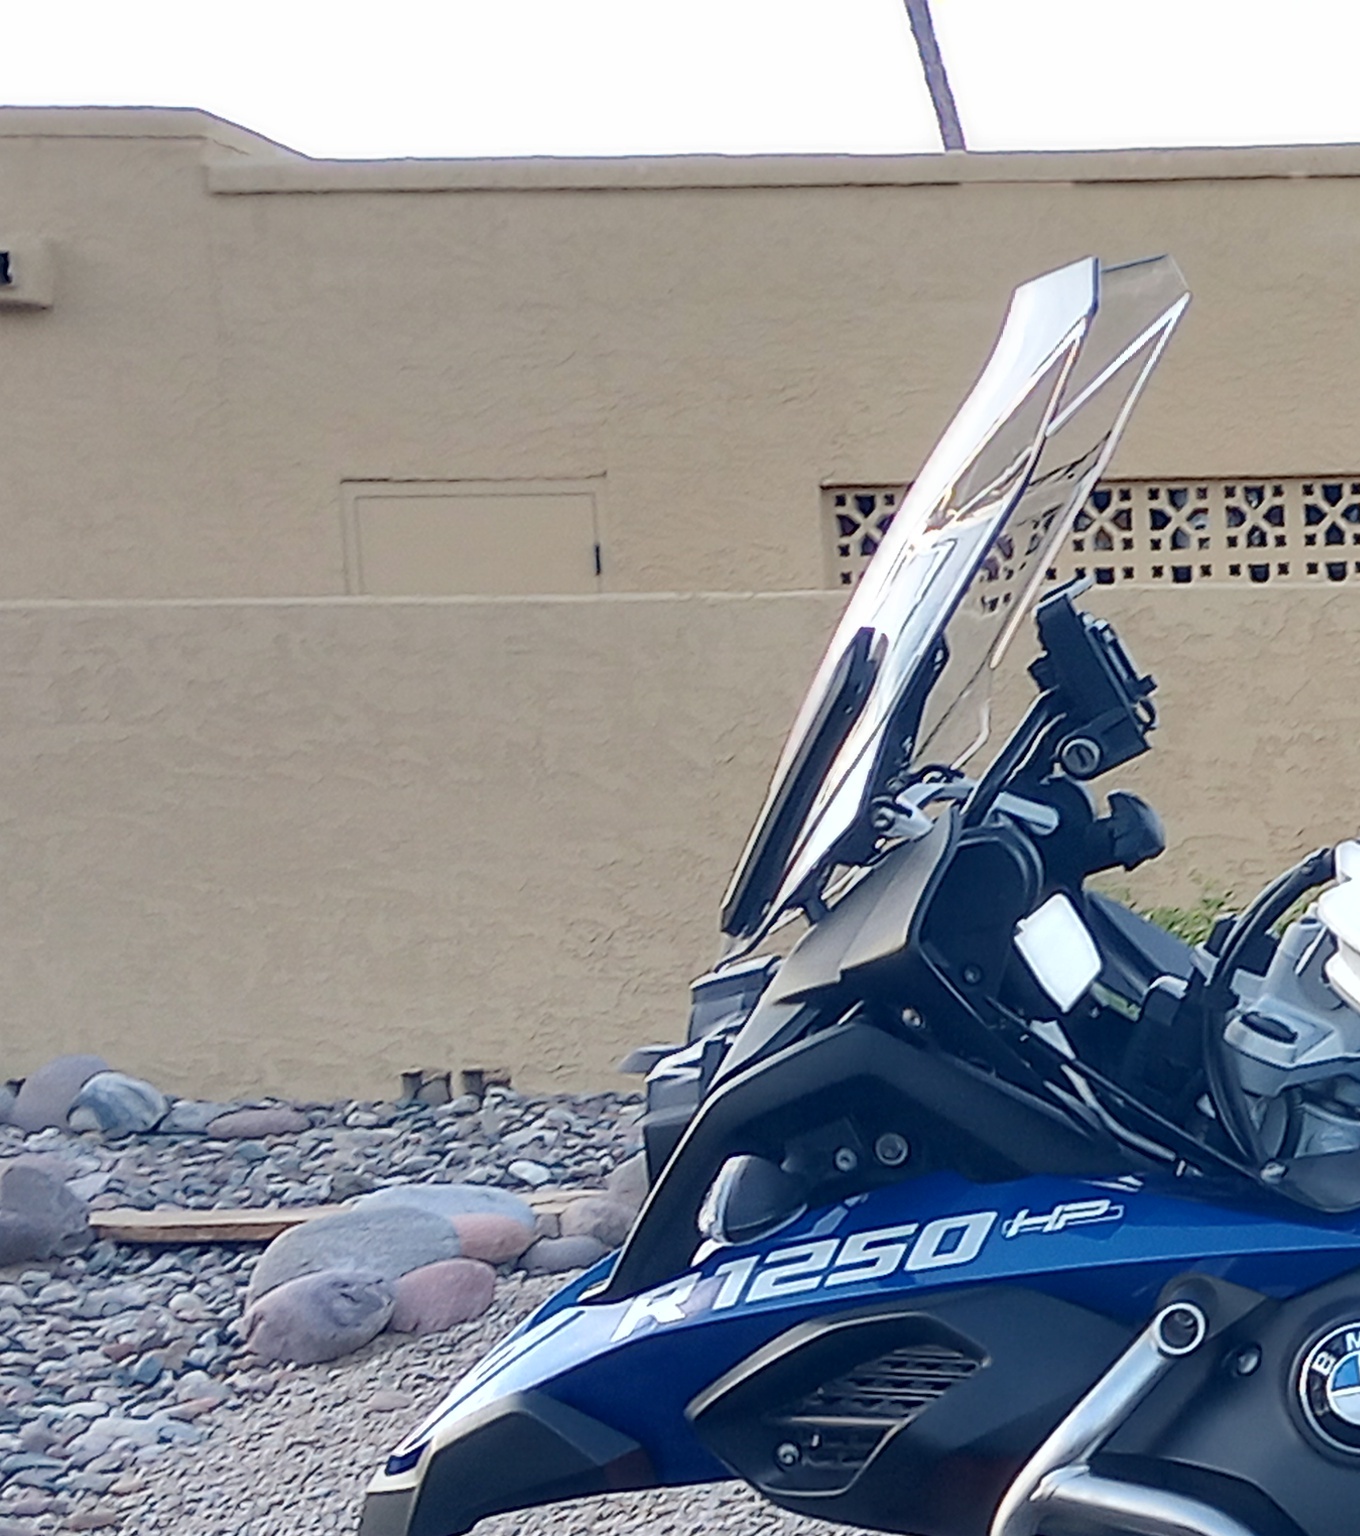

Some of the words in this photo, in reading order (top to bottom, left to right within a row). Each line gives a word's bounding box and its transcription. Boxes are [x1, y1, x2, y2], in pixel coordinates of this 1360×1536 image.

[609, 1271, 703, 1343] R
[711, 1211, 999, 1311] 1250
[1002, 1198, 1125, 1240] HP
